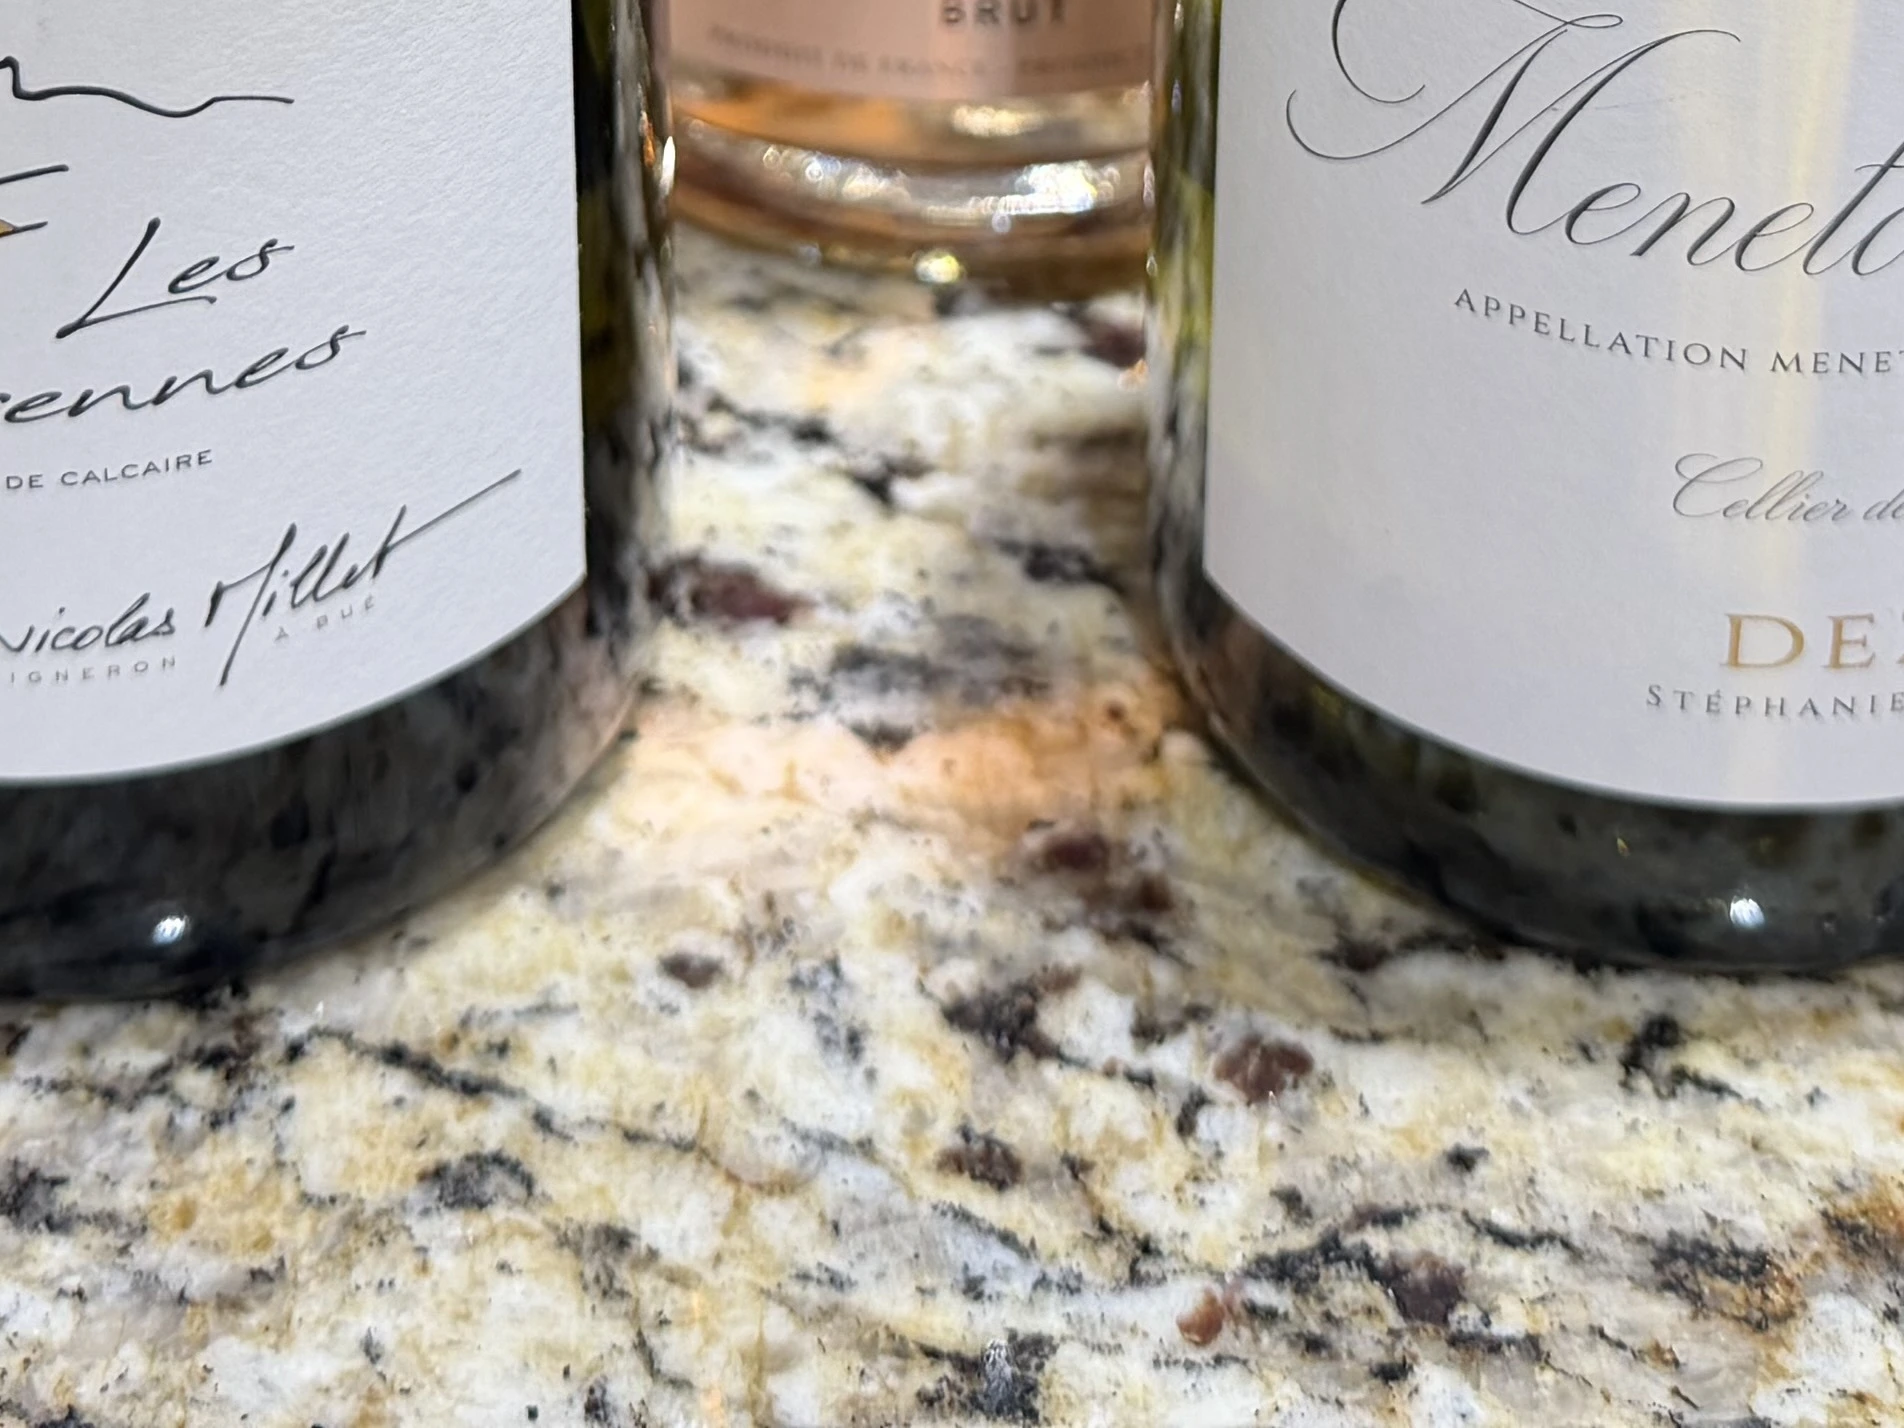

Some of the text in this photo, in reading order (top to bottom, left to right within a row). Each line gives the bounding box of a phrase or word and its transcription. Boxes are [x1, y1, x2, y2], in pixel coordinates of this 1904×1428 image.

[57, 217, 295, 339] Les
[1454, 287, 1750, 374] APPELLATION
[4, 471, 46, 492] DE
[59, 448, 215, 488] CALCAIRE
[1672, 452, 1854, 524] Cellier
